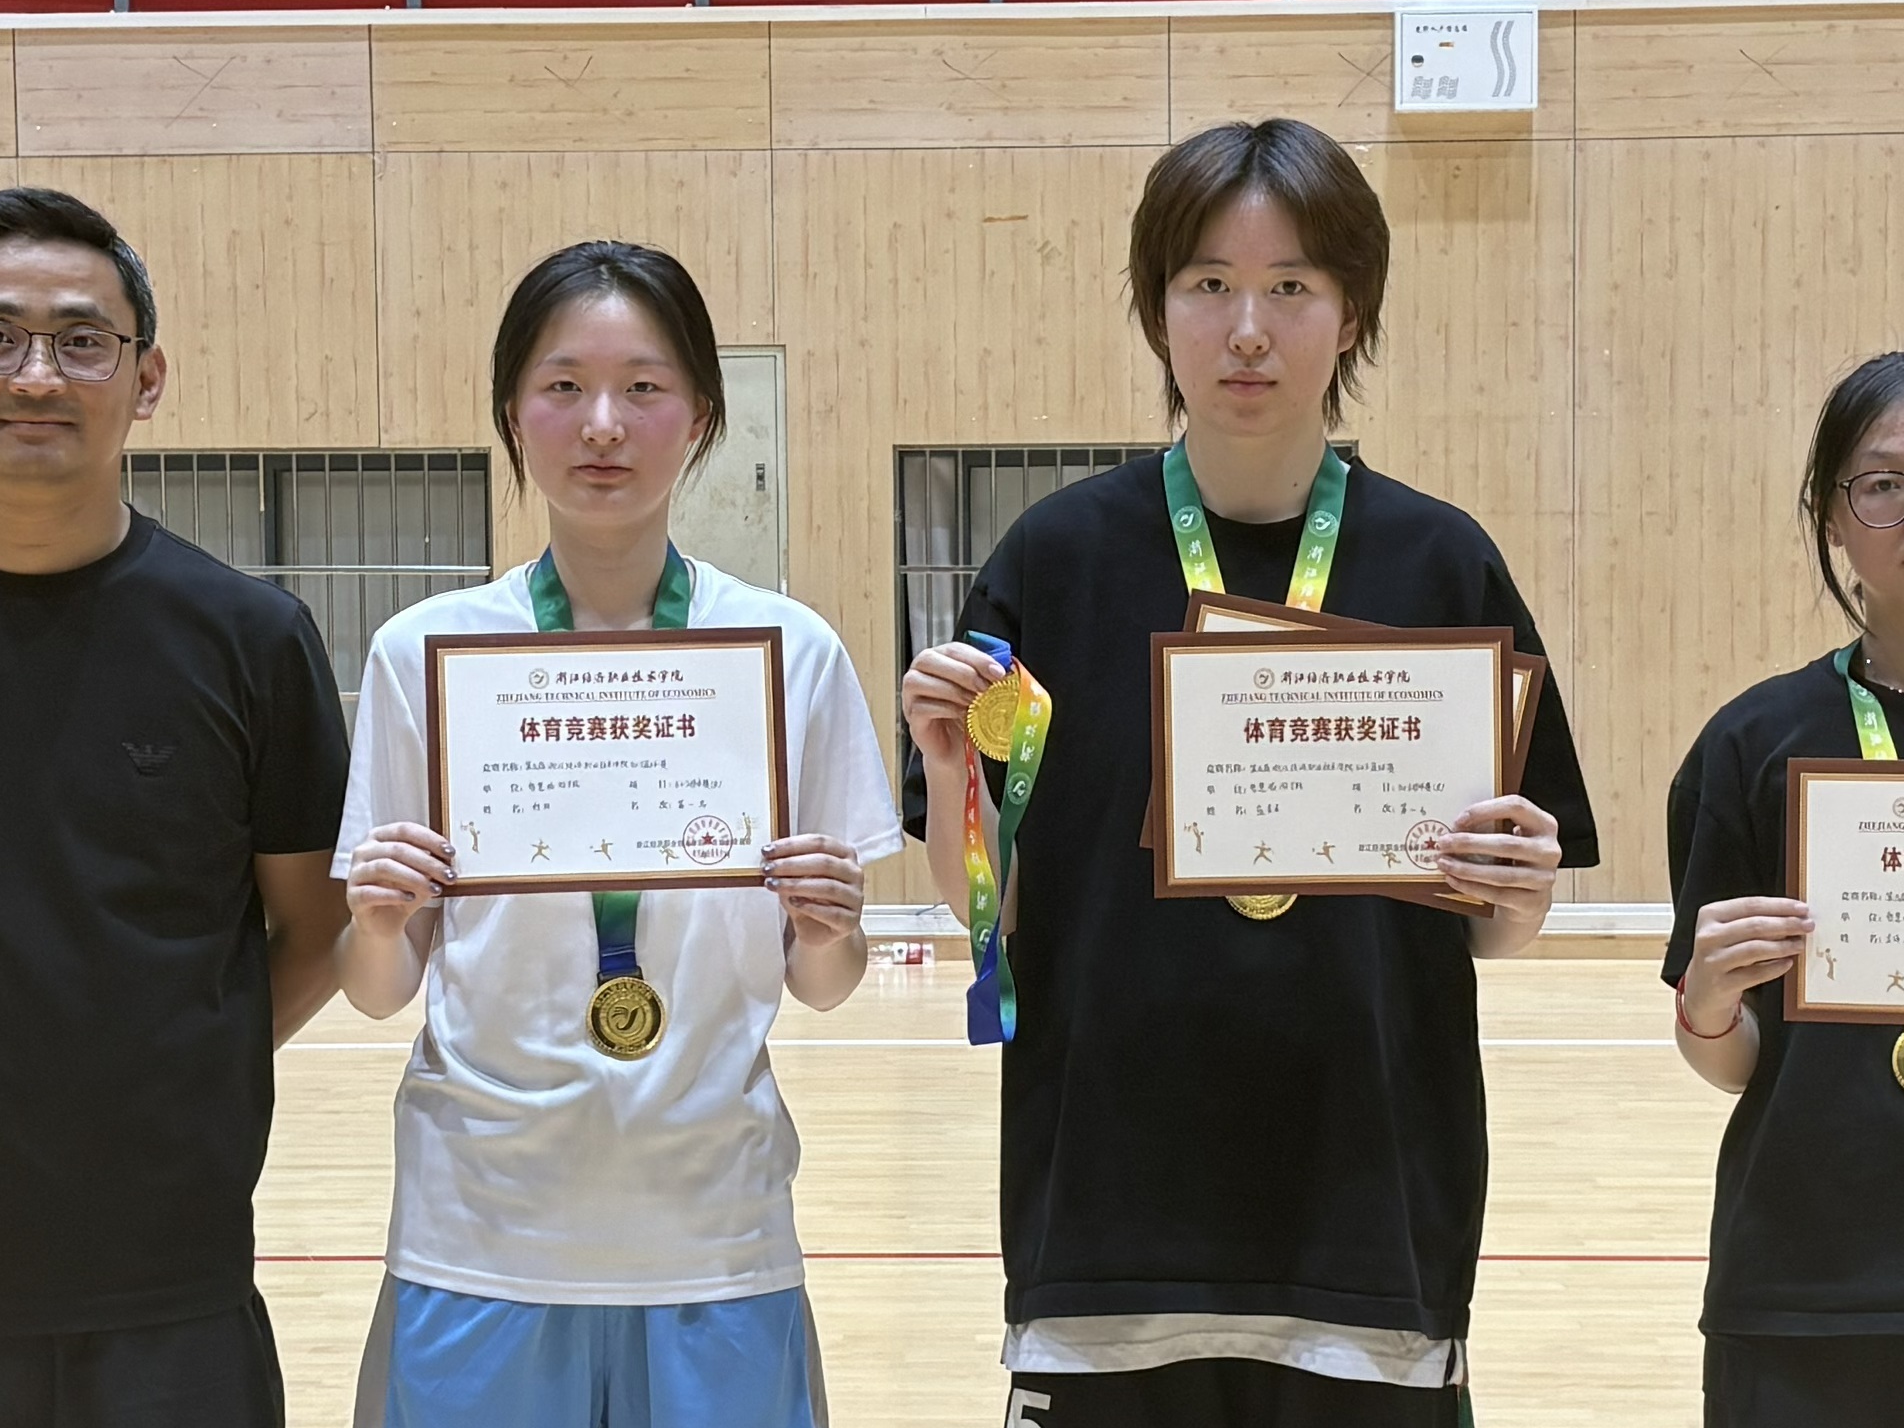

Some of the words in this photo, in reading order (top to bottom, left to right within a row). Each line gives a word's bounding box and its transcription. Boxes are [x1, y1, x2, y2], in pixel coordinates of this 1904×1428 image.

[519, 713, 696, 743] 体育竞赛获奖证书
[1244, 716, 1422, 744] 体育竞赛获奖证书
